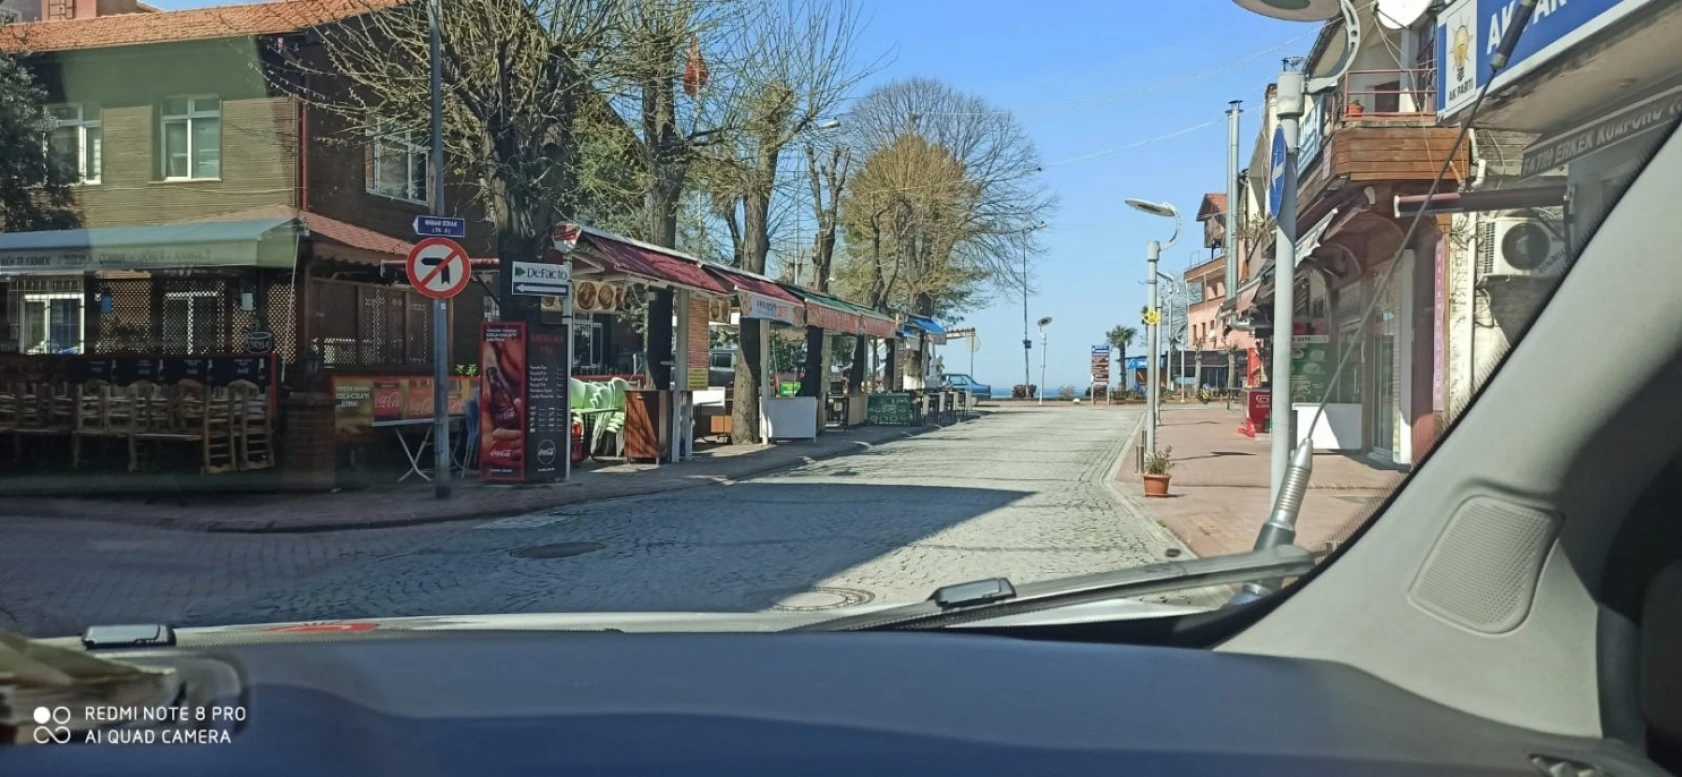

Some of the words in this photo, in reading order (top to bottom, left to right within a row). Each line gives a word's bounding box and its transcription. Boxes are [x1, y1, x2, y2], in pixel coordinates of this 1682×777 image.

[1448, 89, 1457, 102] AK
[1554, 130, 1595, 163] ERKEK
[527, 267, 568, 280] DeFacto
